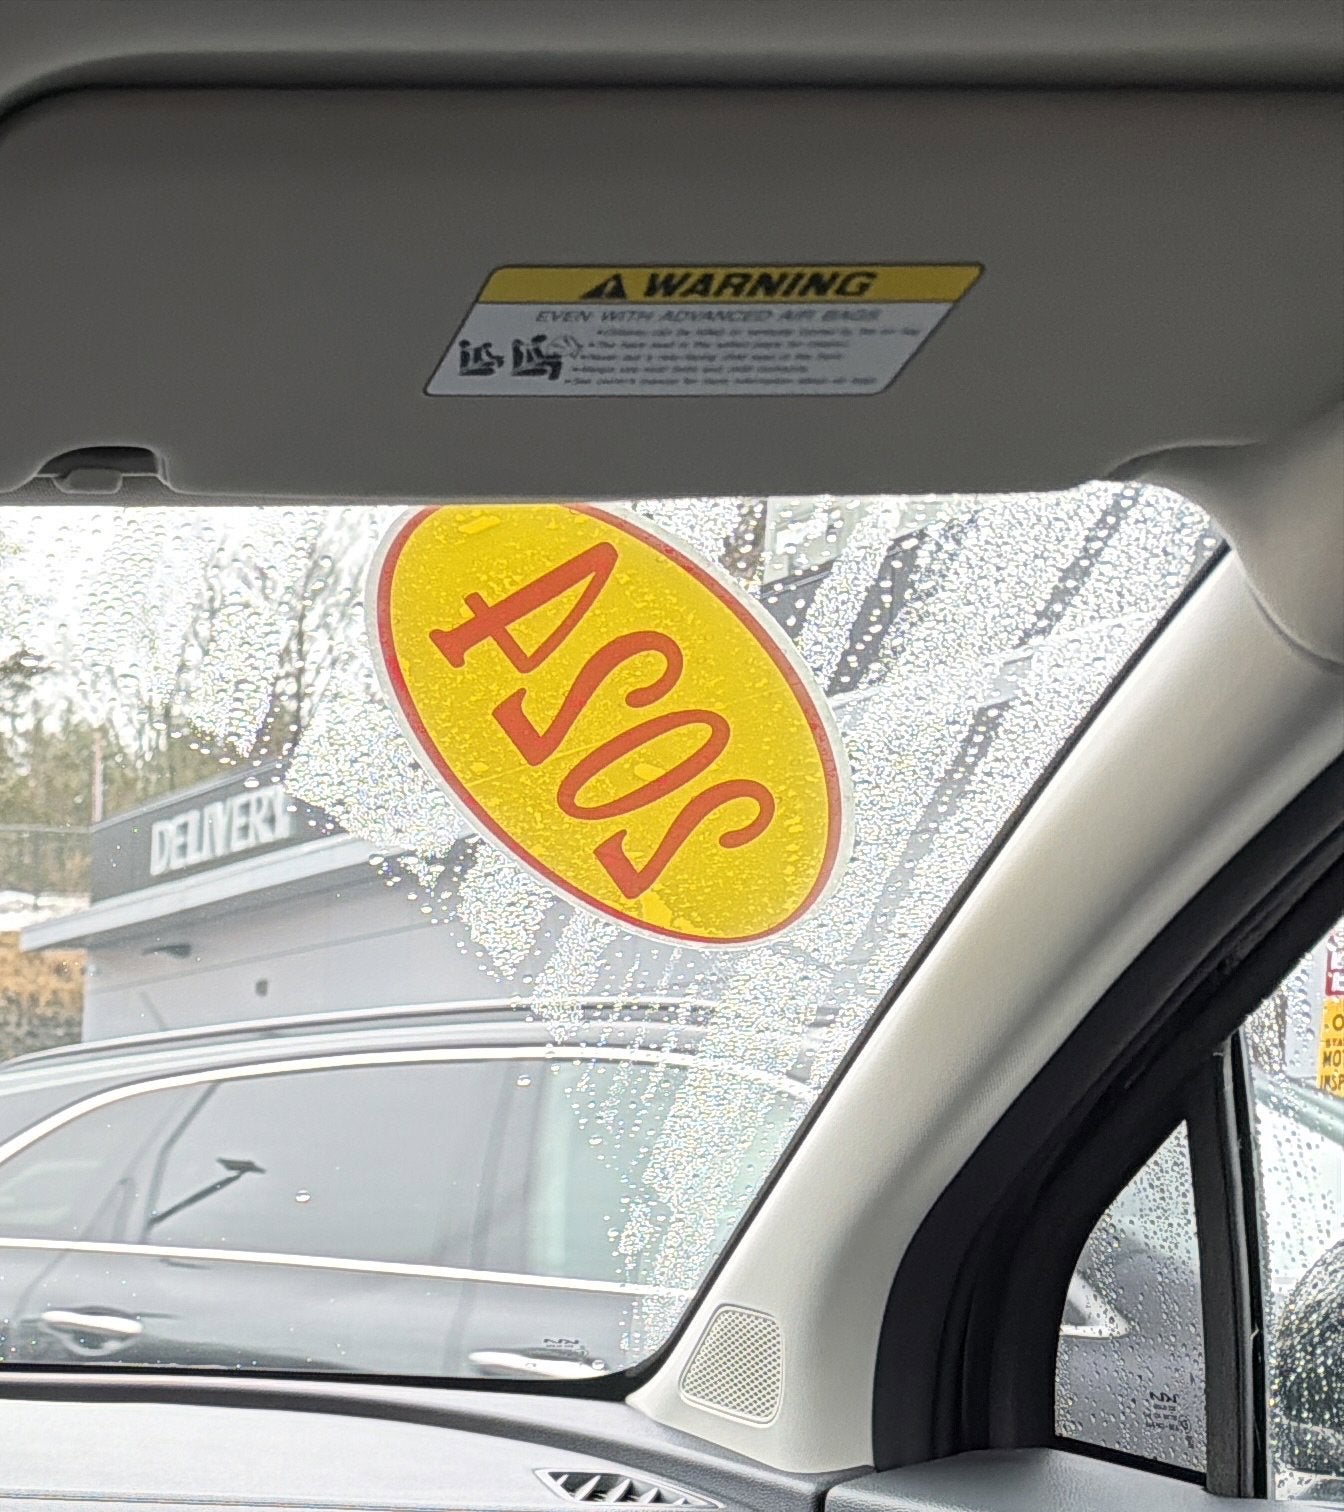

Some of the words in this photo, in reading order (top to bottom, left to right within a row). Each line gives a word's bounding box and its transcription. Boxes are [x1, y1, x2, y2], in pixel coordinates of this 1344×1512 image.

[643, 273, 880, 298] WARNING
[535, 310, 591, 322] EVEN
[600, 310, 654, 322] WITH
[660, 310, 772, 322] ADVANCED
[779, 310, 817, 322] AIR
